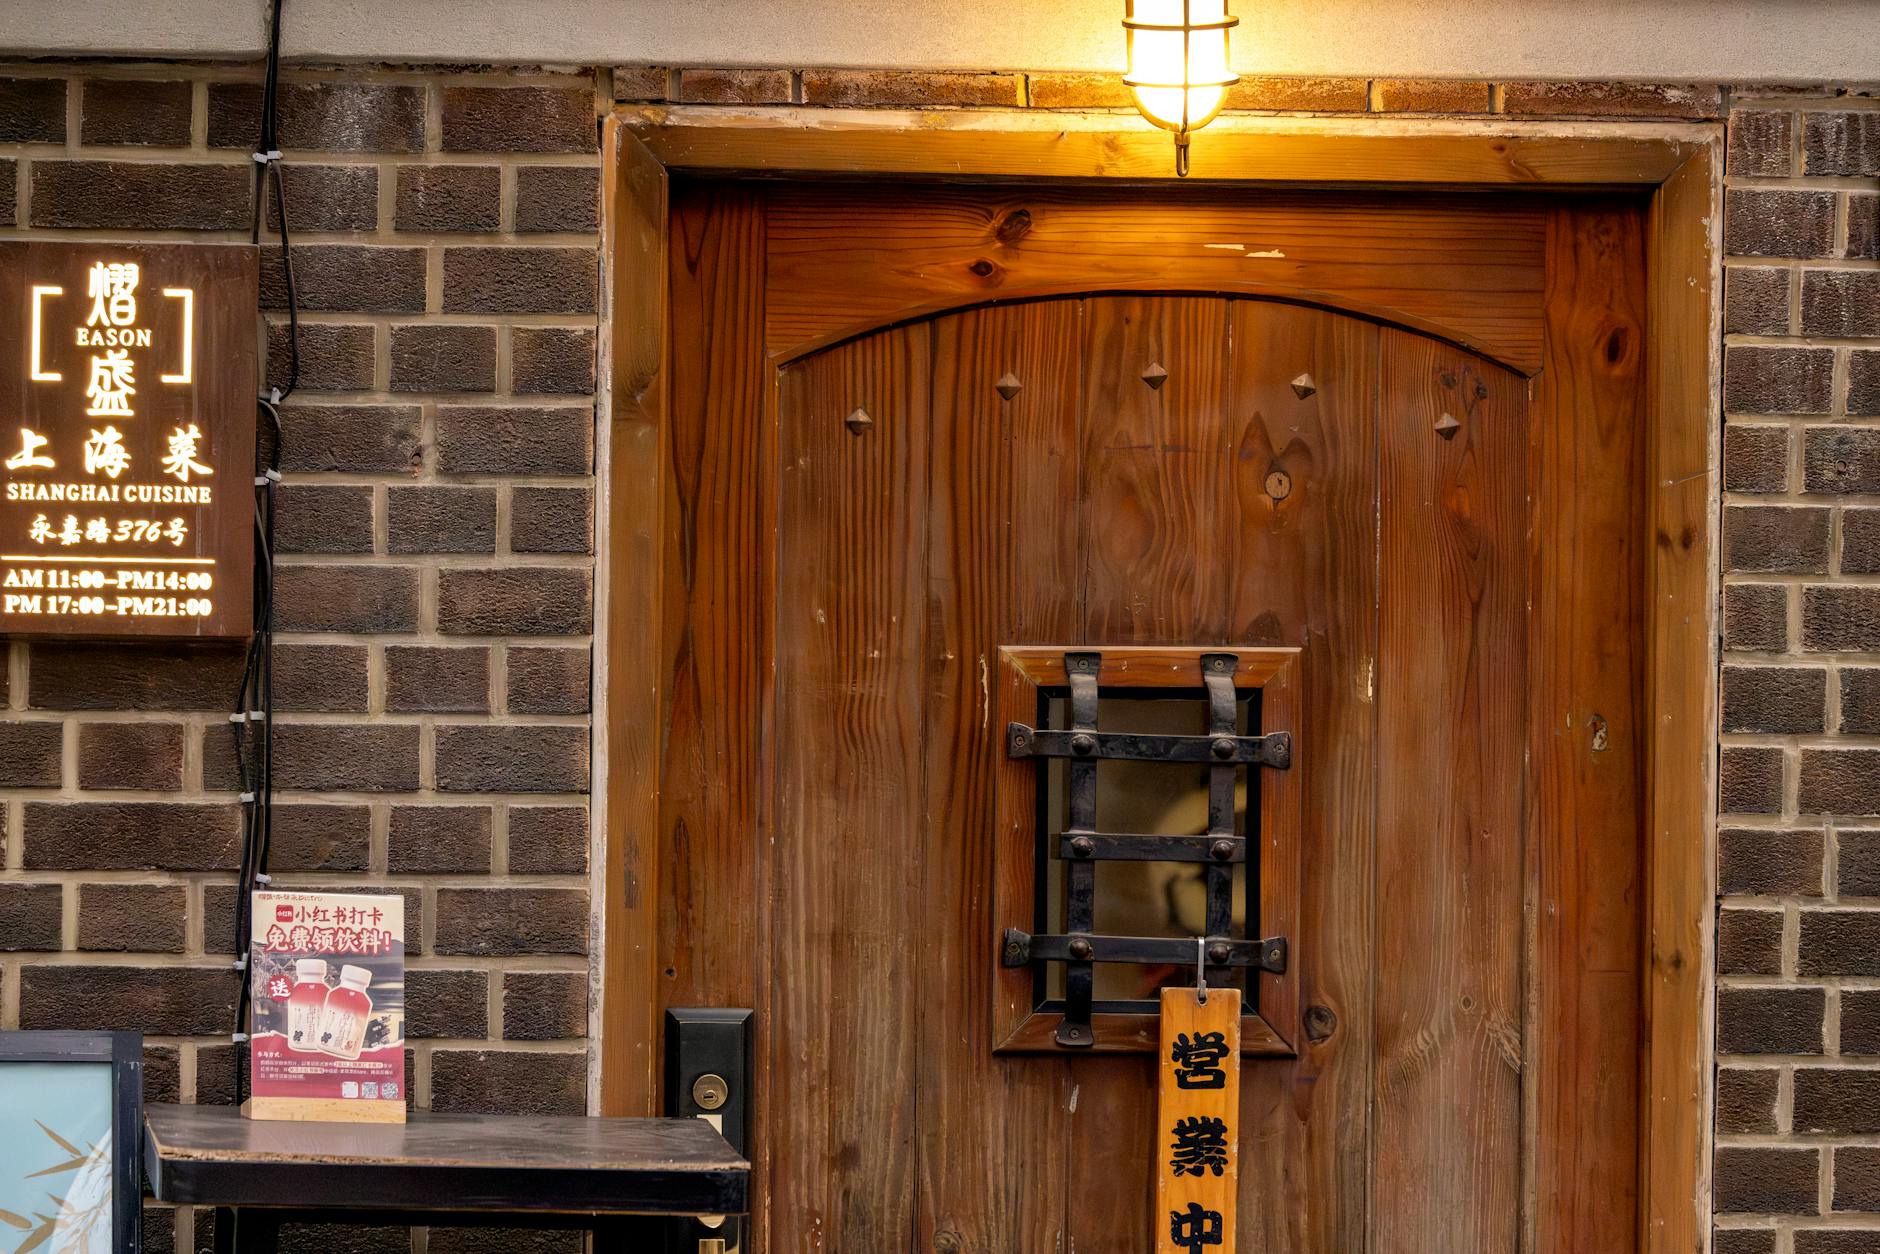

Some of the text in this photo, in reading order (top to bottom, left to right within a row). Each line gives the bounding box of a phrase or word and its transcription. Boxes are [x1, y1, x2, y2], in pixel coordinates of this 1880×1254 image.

[75, 327, 152, 347] EASON
[86, 348, 136, 416] 盛
[5, 425, 214, 482] 上海菜
[7, 483, 212, 503] SHANGHAI CUISINE
[3, 569, 43, 588] AM
[4, 595, 42, 613] PM
[295, 905, 384, 926] 小红书打卡
[270, 978, 291, 997] 送
[1170, 1031, 1230, 1254] 営業中
